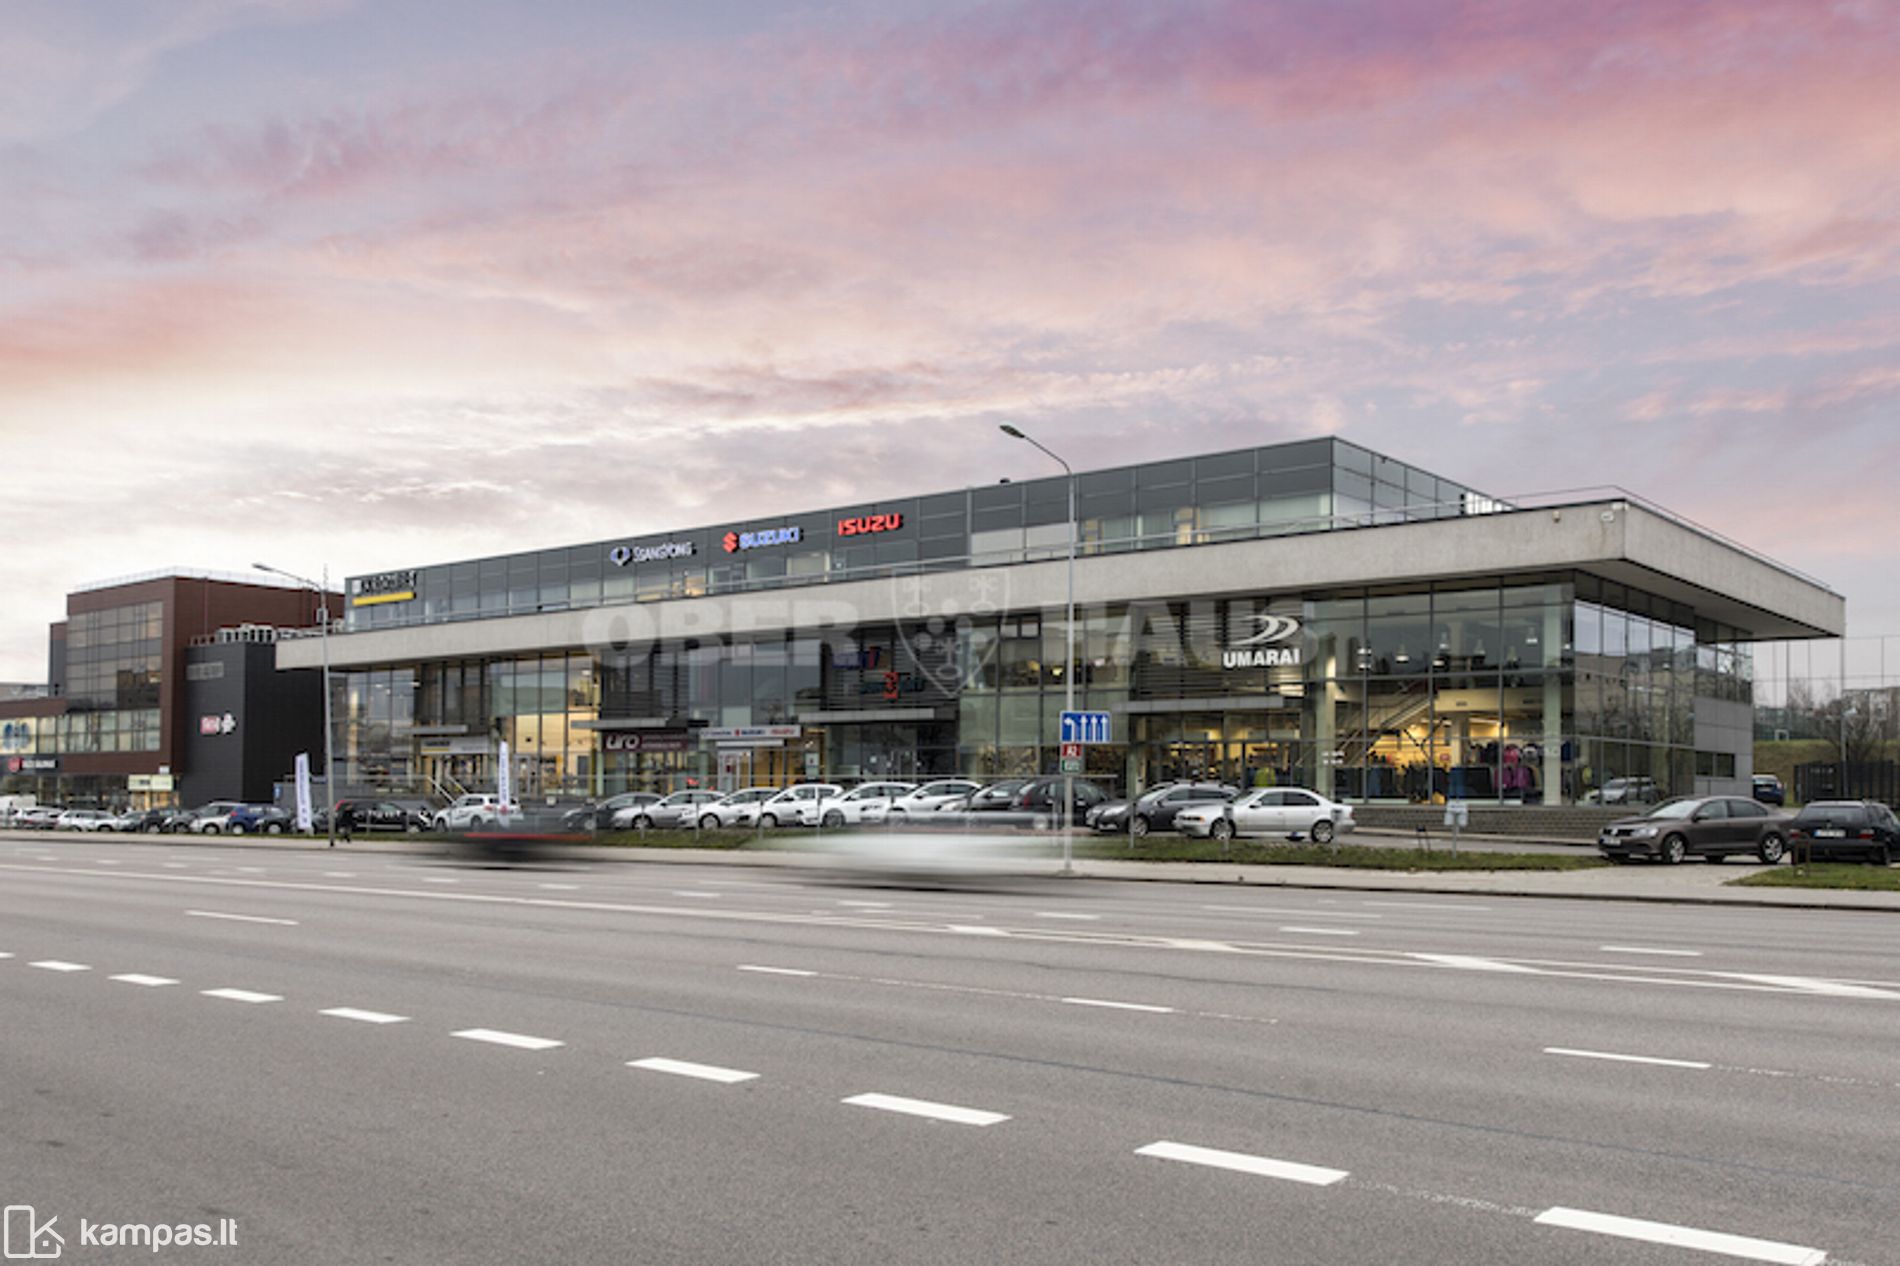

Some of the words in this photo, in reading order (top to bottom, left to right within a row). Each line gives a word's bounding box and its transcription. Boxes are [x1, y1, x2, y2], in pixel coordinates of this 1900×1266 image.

[838, 512, 900, 536] ISUZU
[739, 526, 800, 549] SUZUKI
[1222, 647, 1301, 669] UMARAI
